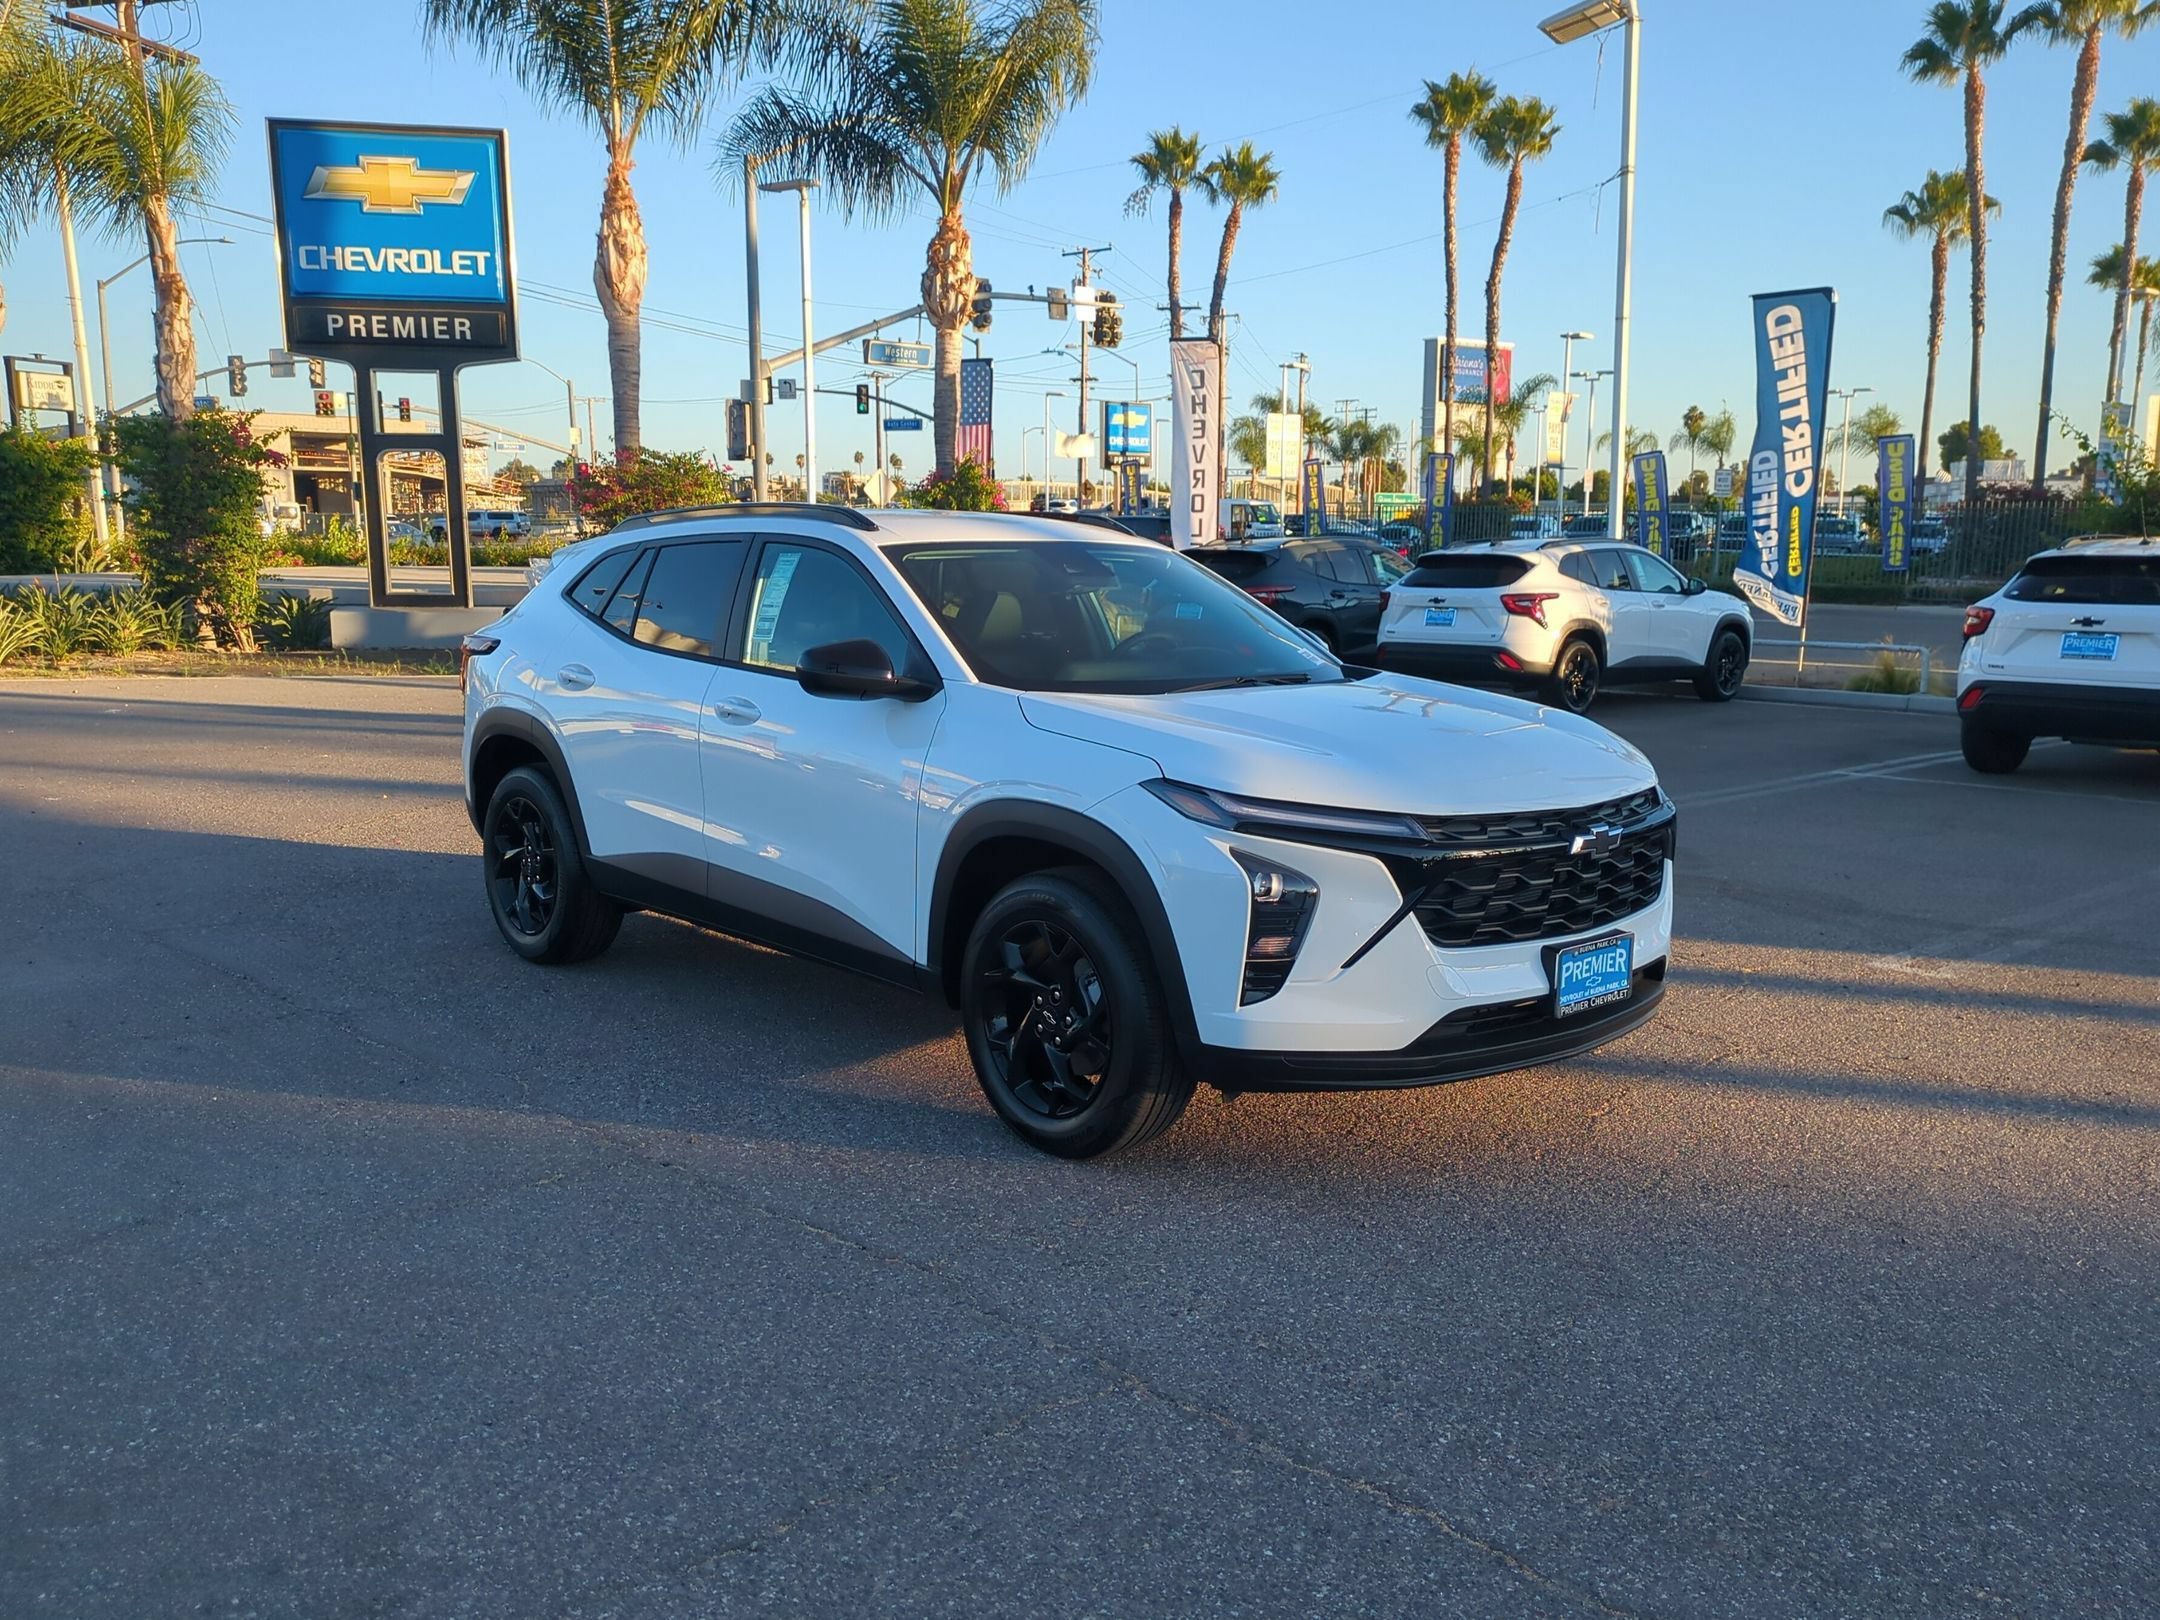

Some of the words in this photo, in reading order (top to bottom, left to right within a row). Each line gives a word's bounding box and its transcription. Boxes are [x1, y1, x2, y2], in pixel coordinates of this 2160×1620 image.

[299, 245, 491, 276] CHEVROLET
[327, 313, 472, 340] PREMIER
[884, 345, 917, 359] Western
[2064, 637, 2114, 650] PREMIER
[1561, 948, 1627, 989] PREMIER
[1560, 1001, 1589, 1016] PREMIER
[1590, 989, 1628, 1007] CHEVROLET
[1590, 985, 1606, 994] BUENA
